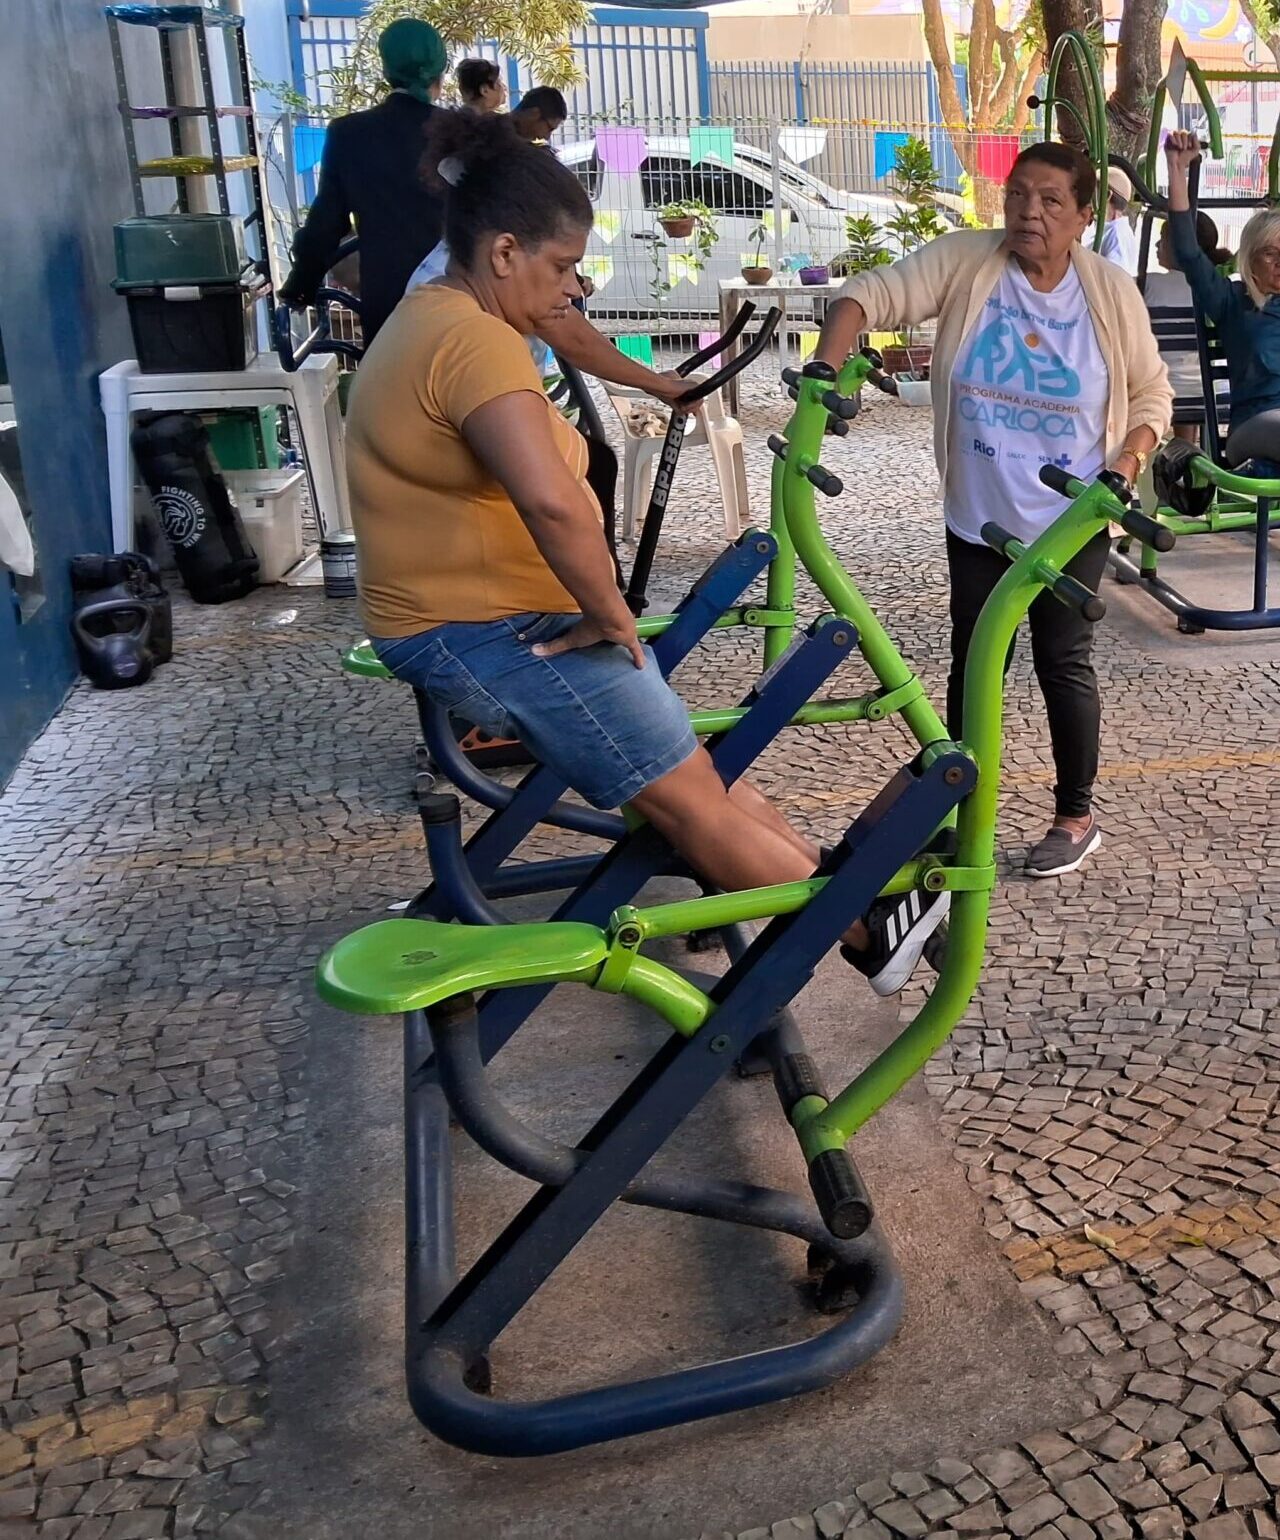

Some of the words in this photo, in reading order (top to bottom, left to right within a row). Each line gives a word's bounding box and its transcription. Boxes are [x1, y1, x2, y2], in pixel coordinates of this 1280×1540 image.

[959, 383, 1020, 405] PROGRAMA
[1024, 398, 1080, 414] ACADEMIA
[959, 396, 1077, 439] CARIOCA
[652, 413, 686, 508] BP-880
[973, 438, 996, 457] Rio
[161, 485, 205, 515] FIGHTING
[197, 517, 206, 531] TO
[182, 533, 202, 548] WIN
